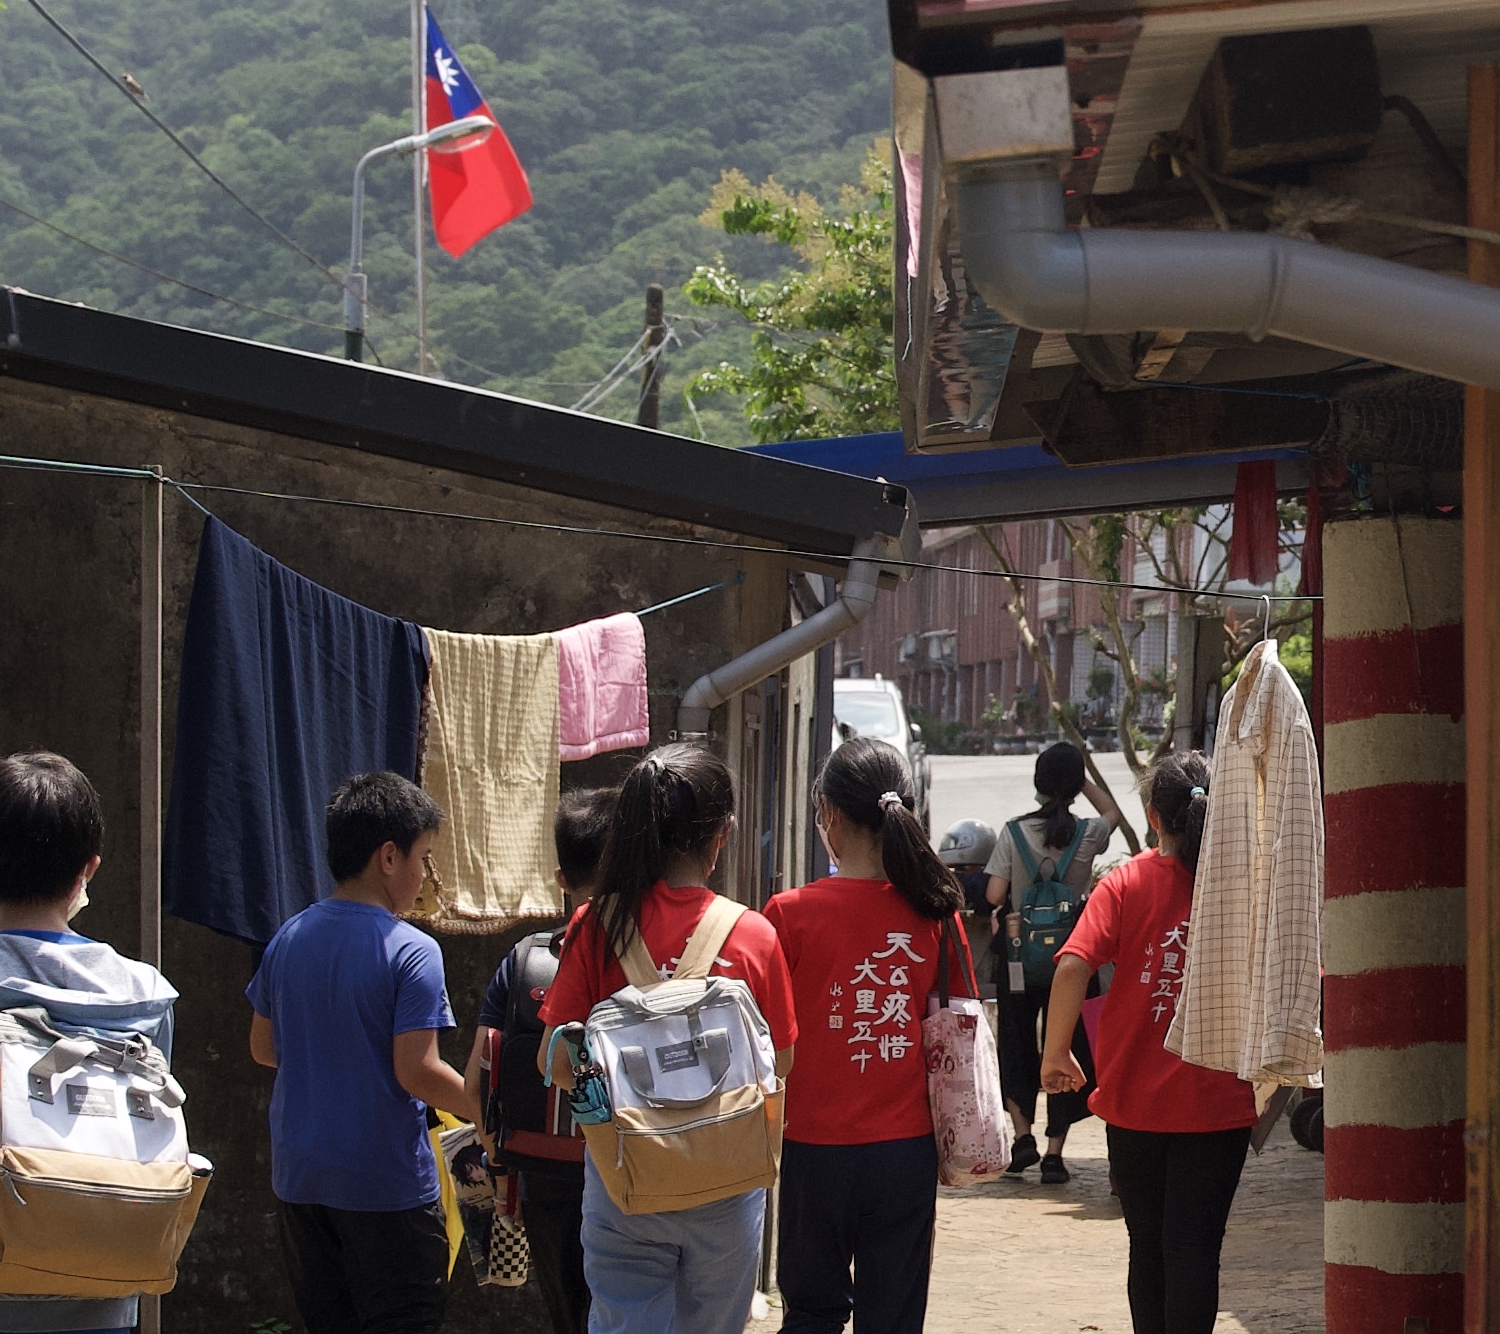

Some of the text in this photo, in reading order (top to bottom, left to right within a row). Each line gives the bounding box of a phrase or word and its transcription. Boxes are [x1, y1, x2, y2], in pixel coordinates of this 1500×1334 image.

[848, 958, 886, 1074] 大里五十
[872, 932, 925, 1063] 天公疼惜
[1151, 926, 1187, 1023] 大里五十
